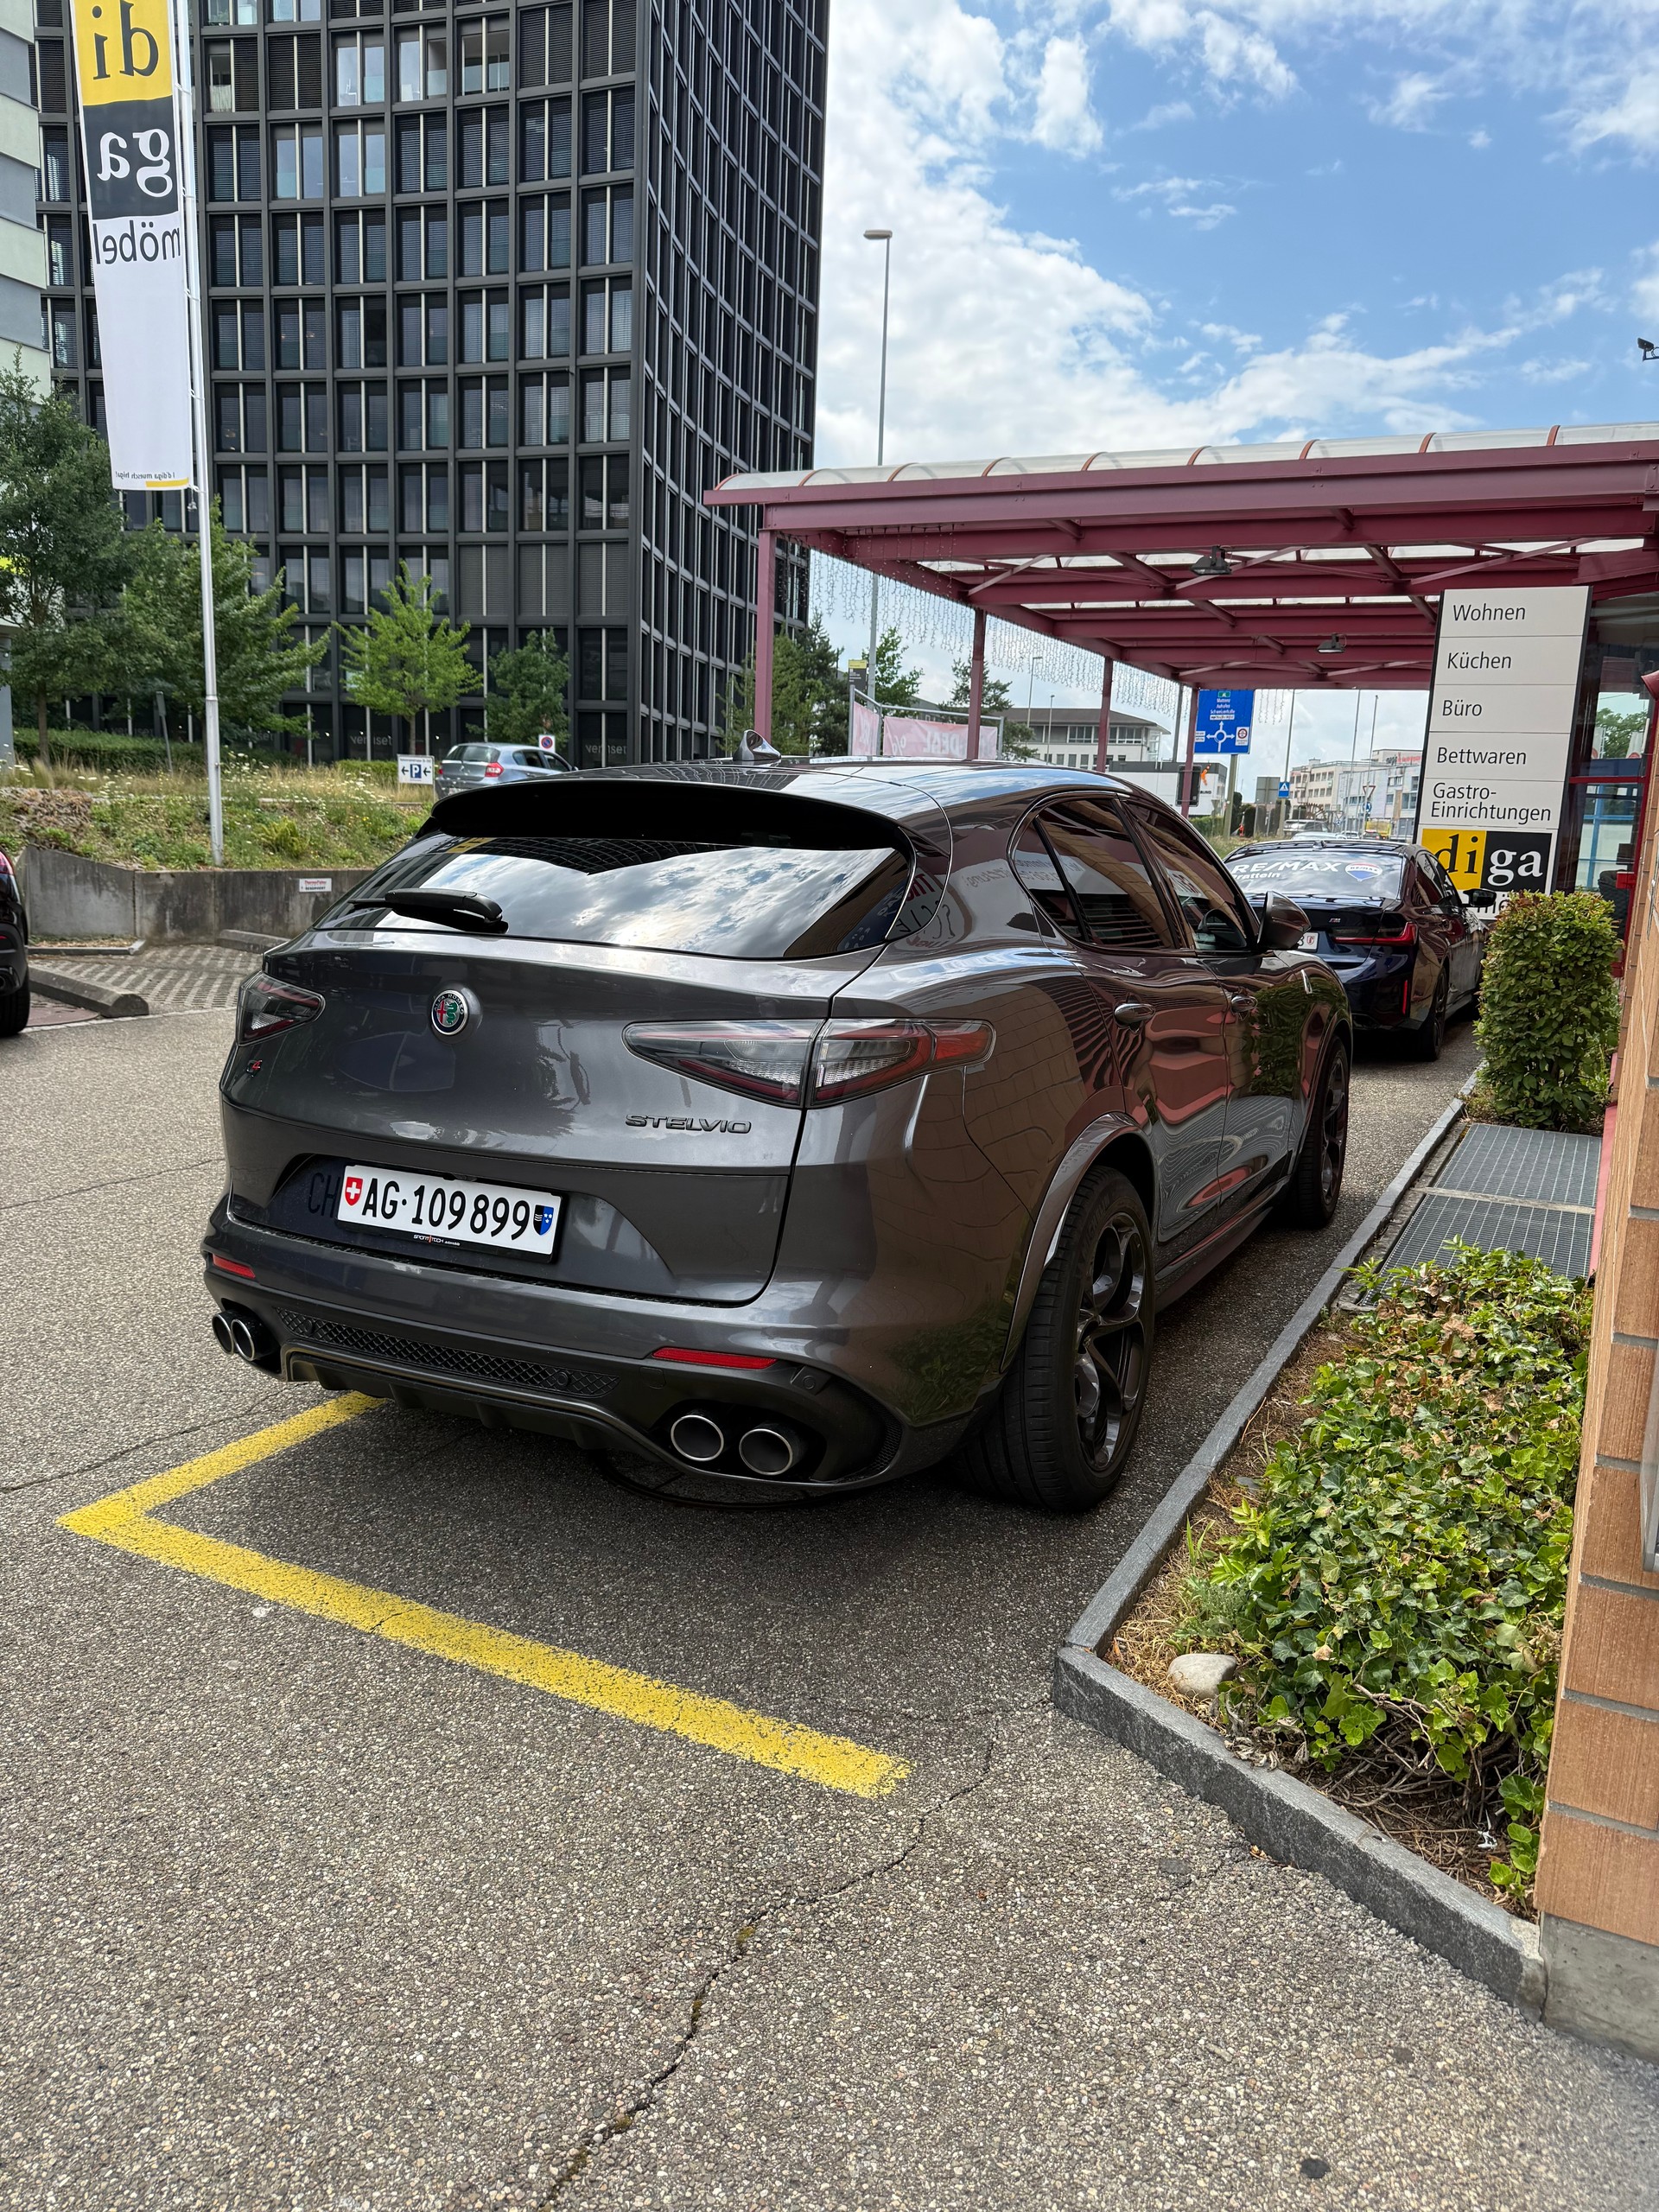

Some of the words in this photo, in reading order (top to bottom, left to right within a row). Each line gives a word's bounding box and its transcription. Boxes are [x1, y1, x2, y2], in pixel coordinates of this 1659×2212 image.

[1452, 602, 1526, 621] Wohnen
[1447, 651, 1512, 670] Küchen
[1442, 699, 1483, 716] Büro
[1437, 747, 1527, 765] Bettwaren
[1433, 782, 1497, 800] Gastro-
[1430, 801, 1552, 825] Einrichtungen
[1231, 861, 1342, 875] RE/MAX
[1433, 833, 1544, 887] diga
[625, 1114, 752, 1135] STELVIO
[308, 1172, 341, 1218] CH
